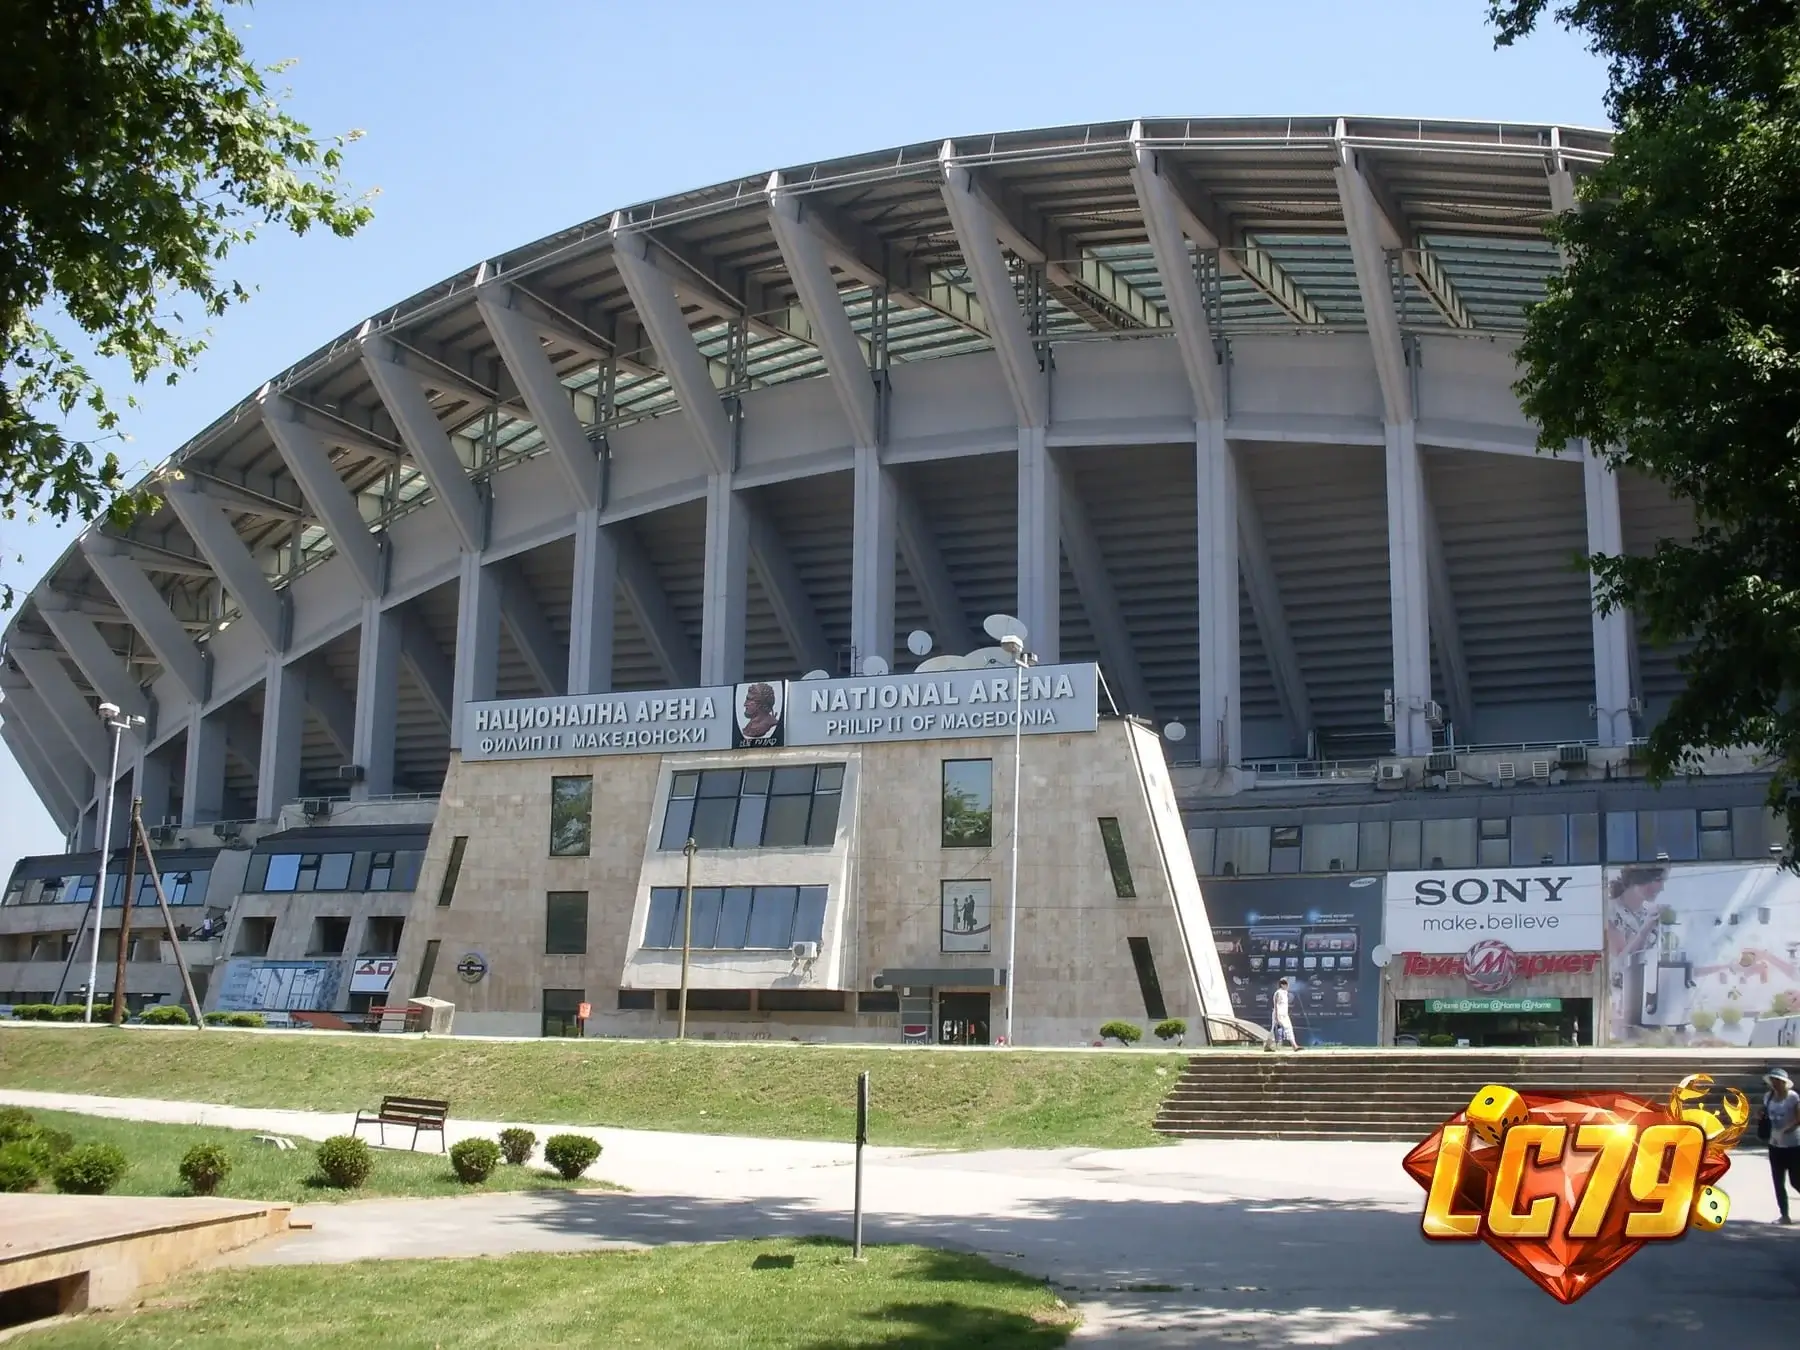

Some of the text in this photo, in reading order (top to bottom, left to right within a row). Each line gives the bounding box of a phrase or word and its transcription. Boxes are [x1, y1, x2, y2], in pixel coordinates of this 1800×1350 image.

[811, 674, 1075, 712] NATIONAL ARENA
[475, 697, 716, 732] НАЦИОНАЛНА АРЕНА
[826, 708, 1057, 735] PHILIP II OF MACEDONIA
[480, 735, 543, 754] ФИЛИП
[572, 727, 707, 748] МАКЕДОНСКИ
[1415, 876, 1573, 906] SONY
[1423, 913, 1560, 931] make.believe
[1460, 1000, 1489, 1012] @Home
[1490, 1000, 1520, 1012] @Home
[1521, 1000, 1552, 1012] @Home
